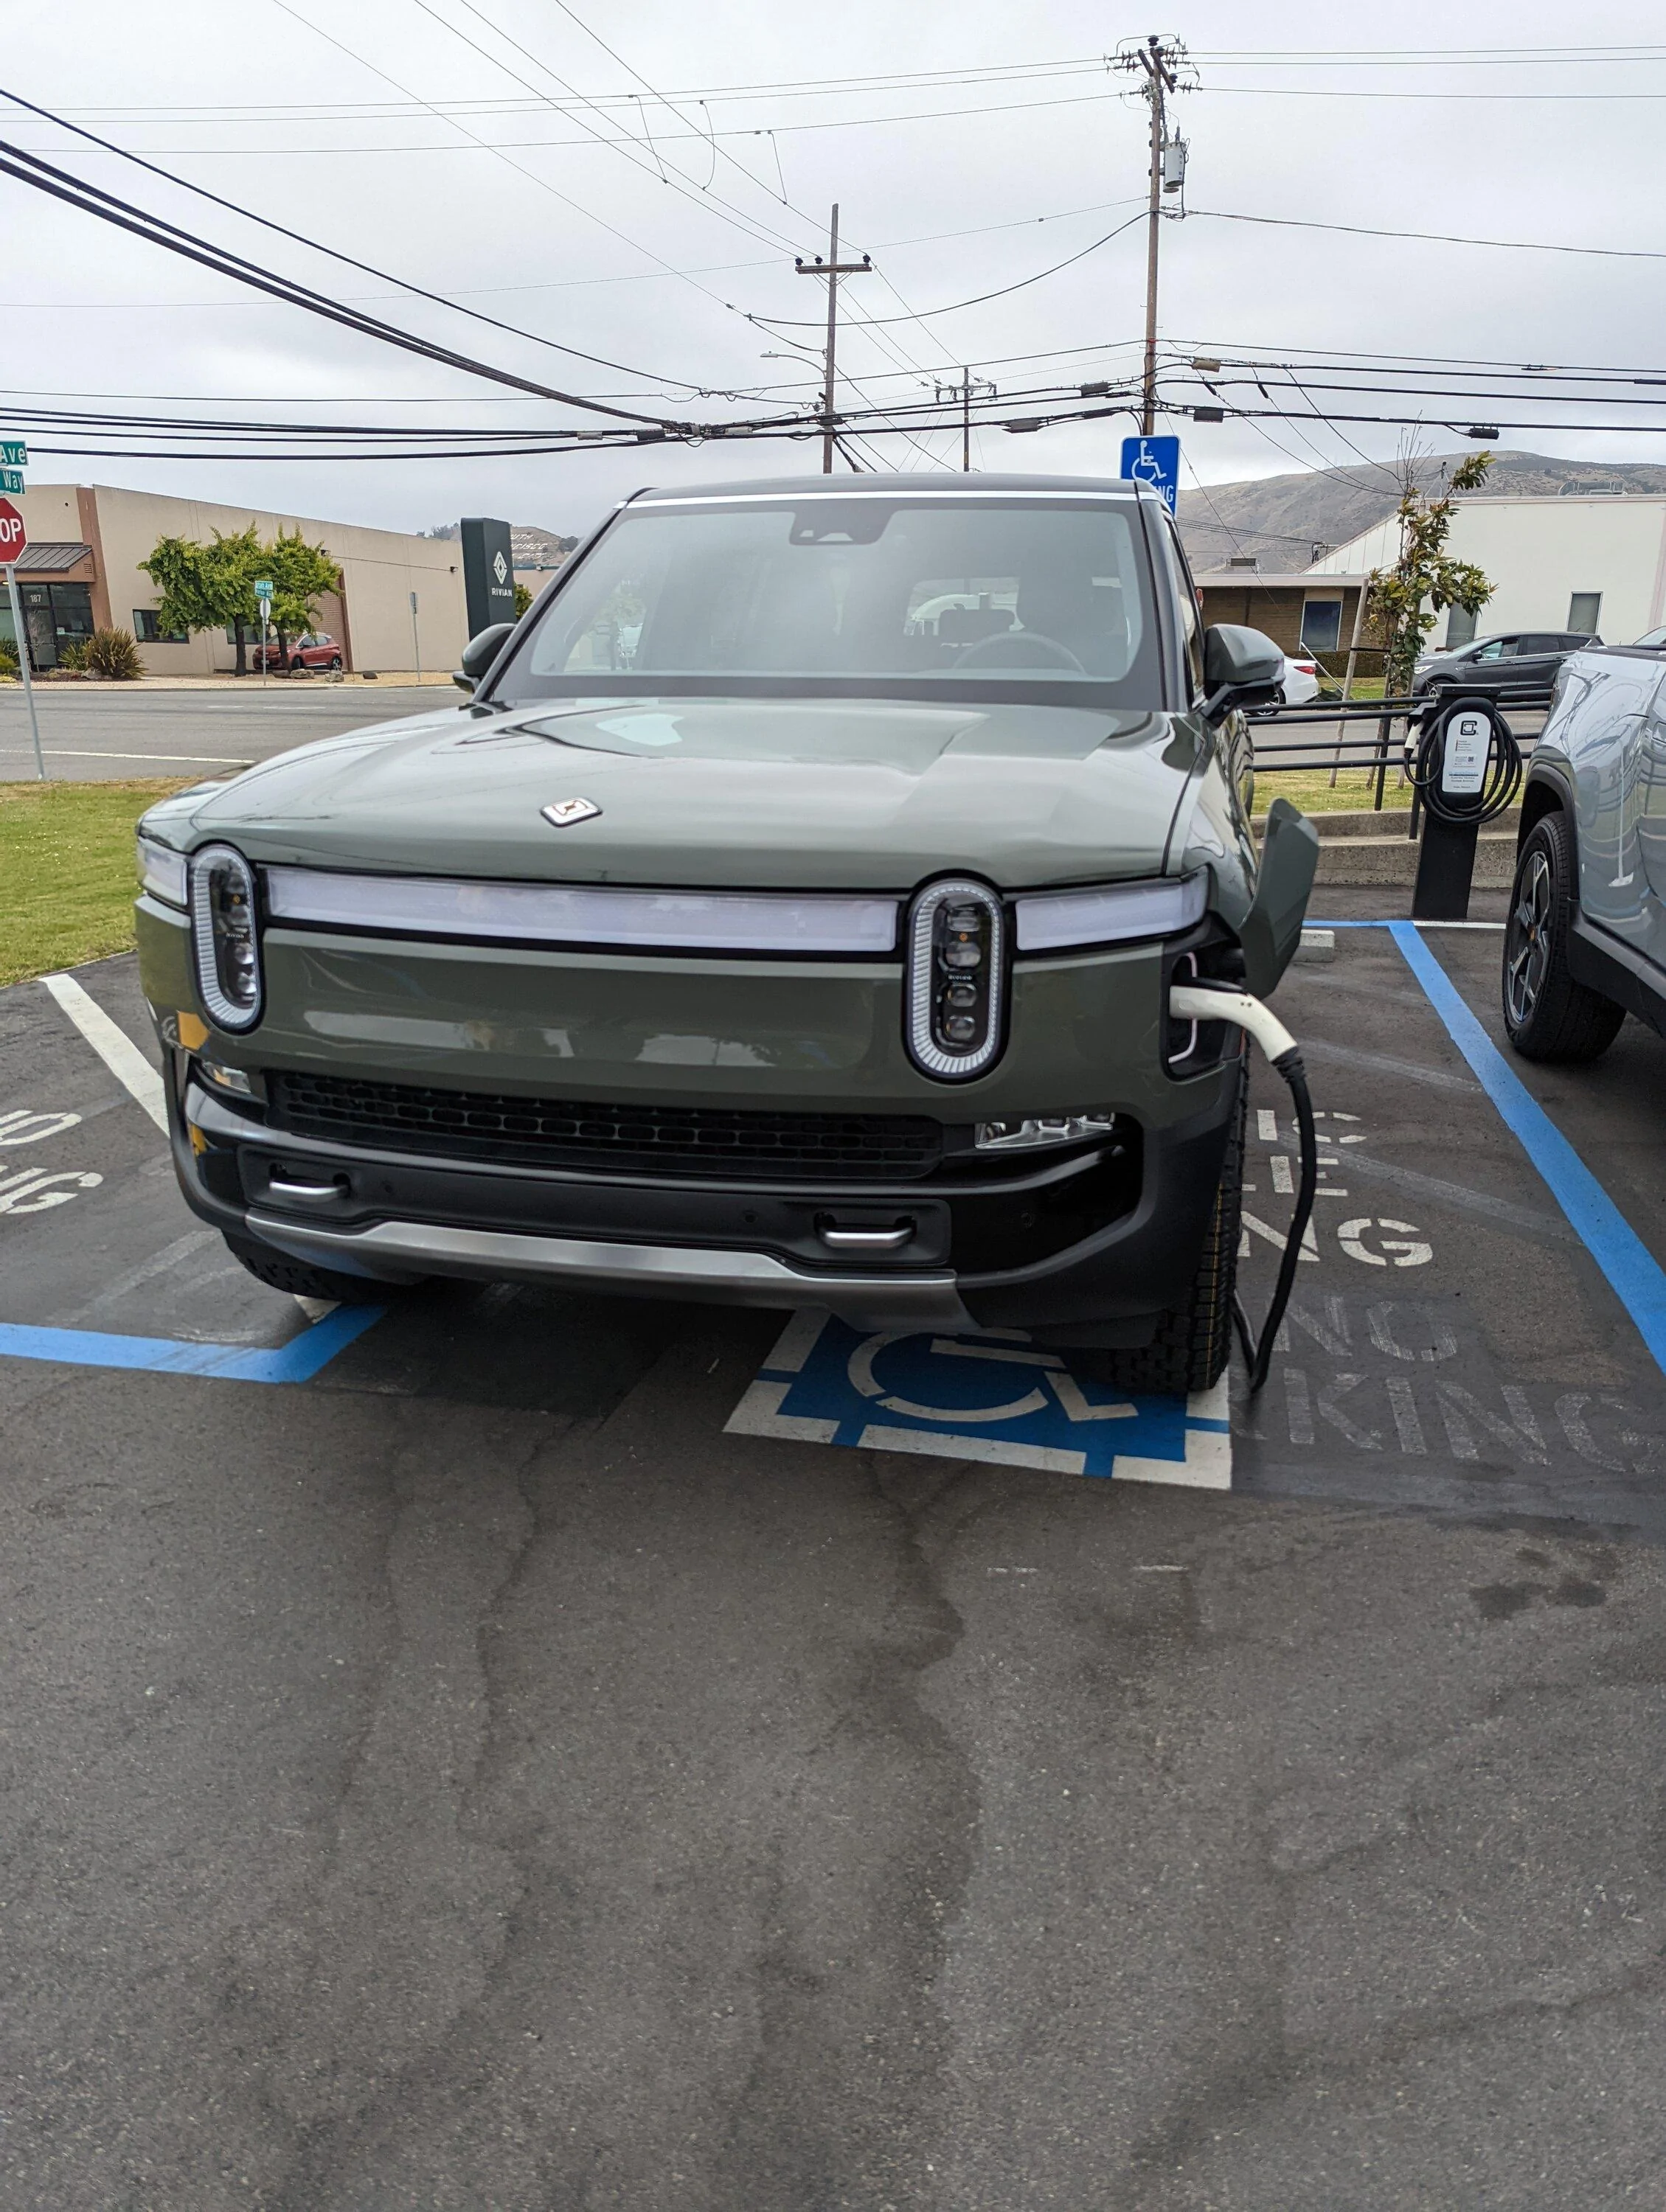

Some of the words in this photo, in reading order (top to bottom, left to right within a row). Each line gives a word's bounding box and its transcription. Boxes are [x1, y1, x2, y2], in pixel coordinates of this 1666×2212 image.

[0, 444, 26, 464] Ave
[3, 470, 24, 495] Way
[0, 518, 22, 543] OP
[30, 594, 41, 602] 187
[491, 588, 513, 597] RIVIAN
[1237, 1210, 1433, 1267] NG
